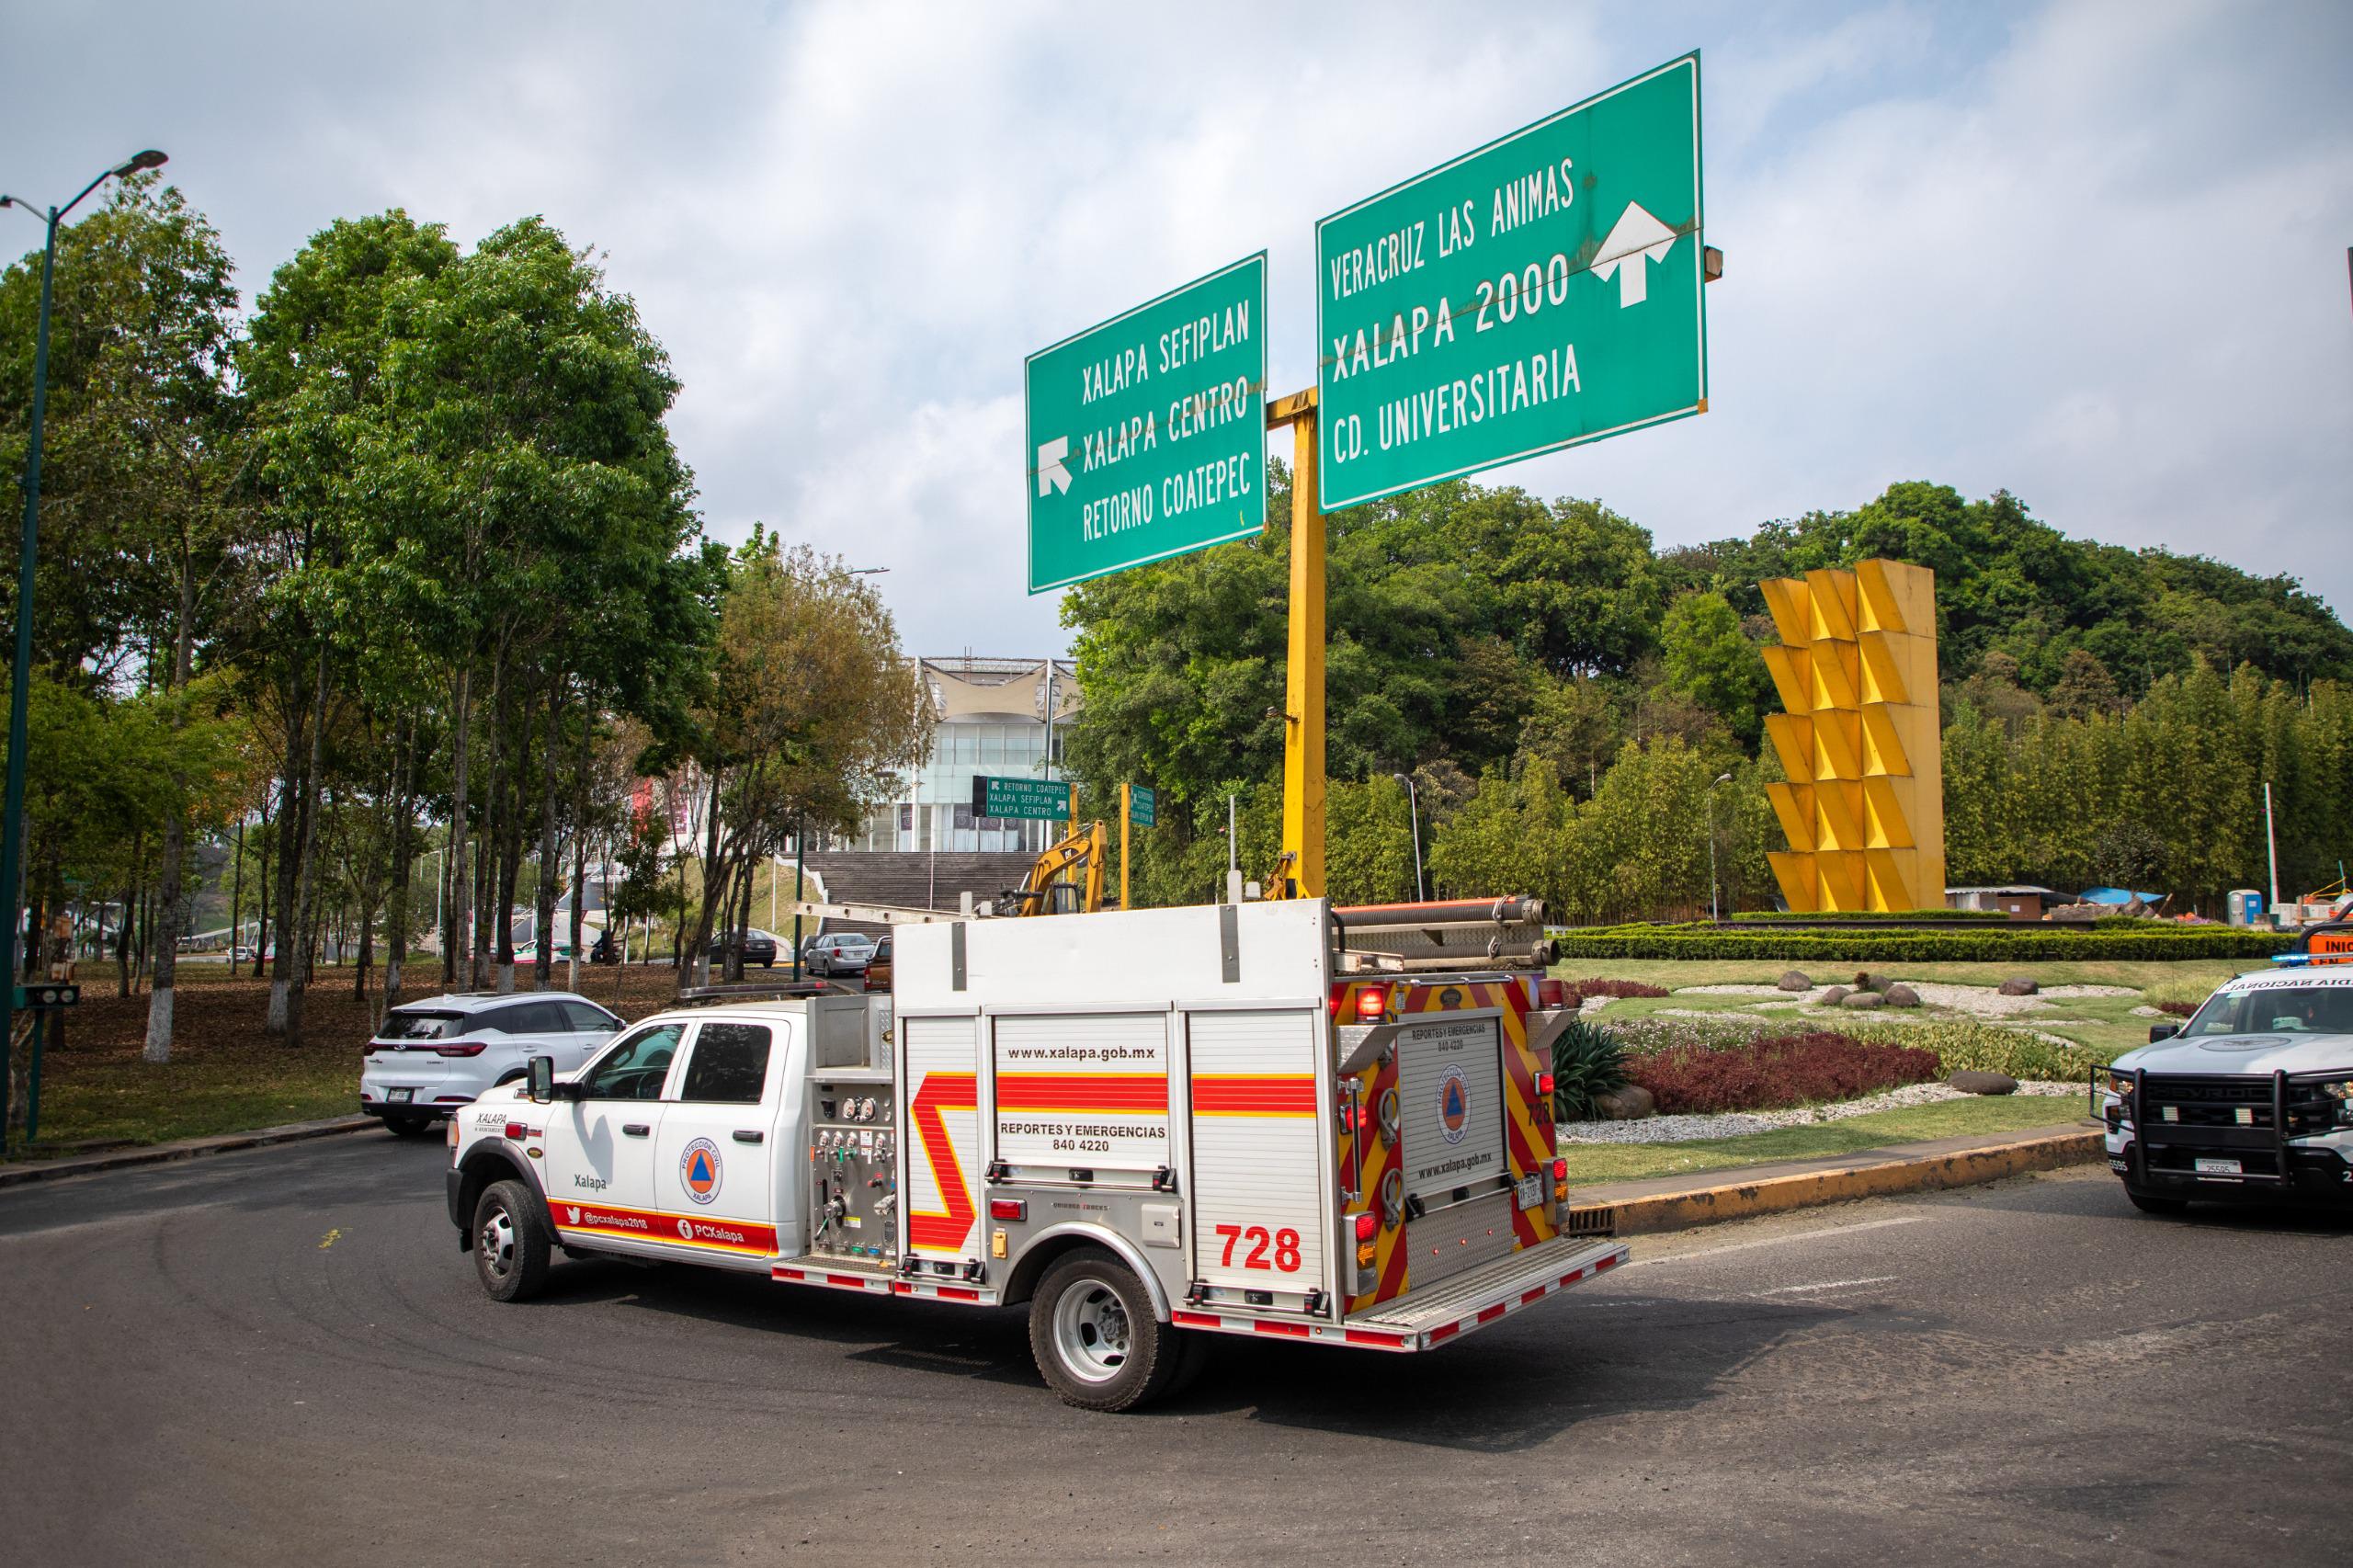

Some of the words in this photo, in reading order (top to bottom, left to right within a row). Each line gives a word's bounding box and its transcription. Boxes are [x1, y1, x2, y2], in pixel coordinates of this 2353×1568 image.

[1331, 221, 1425, 301] VERACRUZ
[1438, 199, 1475, 258] LAS
[1491, 156, 1574, 237] ANIMAS
[1334, 296, 1454, 382] XALAPA
[1475, 254, 1569, 334] 2000
[1082, 344, 1149, 404] XALAPA
[1159, 300, 1249, 373] SEFIPLAN
[1334, 414, 1369, 464] CD.
[1379, 344, 1581, 450] UNIVERSITARIA
[1083, 411, 1157, 472] XALAPA
[1168, 376, 1248, 441] CENTRO
[1085, 483, 1154, 542] RETORNO
[1163, 452, 1251, 517] COATEPEC
[1004, 782, 1032, 792] RETORNO
[1037, 785, 1066, 794] COATEPEC
[989, 793, 1016, 802] XALAPA
[1020, 795, 1052, 804] SEFIPLAN
[989, 805, 1018, 813] XALAPA
[1024, 806, 1051, 816] CENTRO
[1412, 1029, 1443, 1040] REPORTES
[1448, 1024, 1485, 1037] EMERGENCIAS
[1007, 1045, 1155, 1062] www.xalapa.gob.mx
[476, 1112, 507, 1124] XALAPA
[1526, 1101, 1550, 1126] 728
[1001, 1123, 1063, 1135] REPORTES
[1063, 1125, 1071, 1135] Y
[1075, 1125, 1165, 1138] EMERGENCIAS
[1053, 1140, 1075, 1150] 840
[1079, 1141, 1109, 1152] 4220
[711, 1150, 720, 1169] CIVIL
[1418, 1152, 1493, 1179] www.xalapa.gob.mx
[574, 1175, 607, 1192] Xalapa
[693, 1192, 711, 1201] XALAPA
[585, 1211, 648, 1230] @pcxalapa2018
[695, 1224, 745, 1243] PCXalapa
[1215, 1224, 1302, 1273] 728
